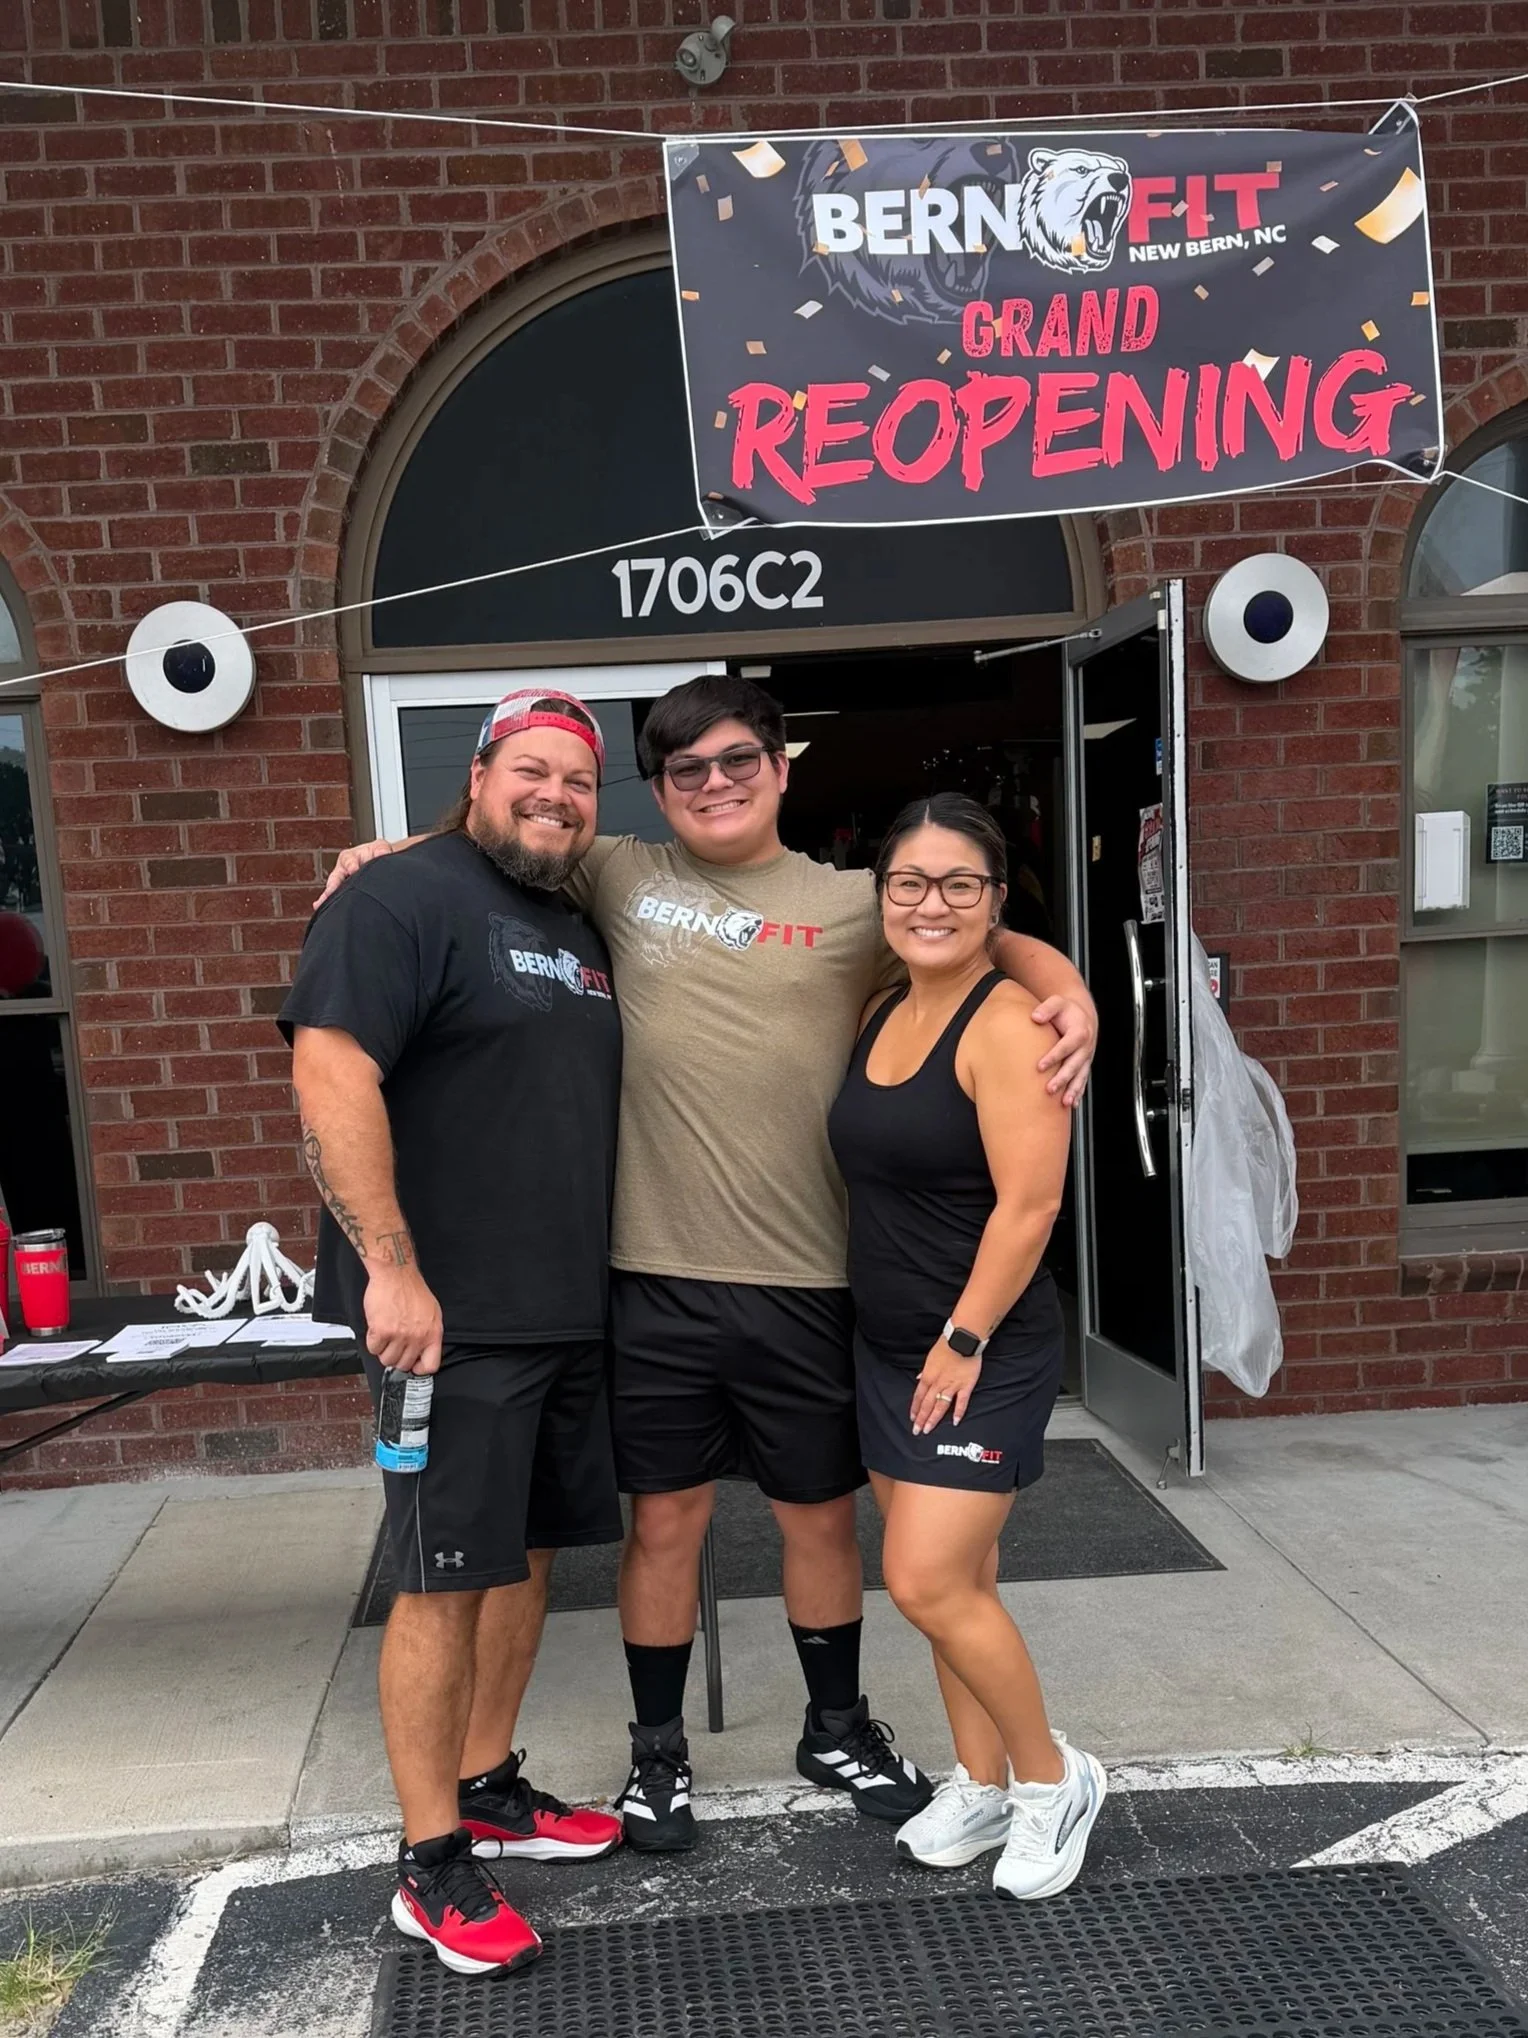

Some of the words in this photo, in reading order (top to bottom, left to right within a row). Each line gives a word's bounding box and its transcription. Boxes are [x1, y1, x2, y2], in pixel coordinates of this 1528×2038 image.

[811, 182, 1022, 255] BERN
[1128, 171, 1281, 243] FIT
[1128, 243, 1181, 262] NEW
[1185, 233, 1250, 257] BERN,
[1253, 224, 1287, 245] NC
[961, 284, 1160, 358] GRAND
[727, 348, 1416, 506] REOPENING
[611, 550, 824, 618] 1706C2
[637, 896, 721, 936] BERN
[757, 920, 823, 949] FIT
[509, 948, 563, 981] BERN
[581, 966, 610, 993] FIT
[937, 1444, 969, 1457] BERN
[982, 1450, 1003, 1460] FIT
